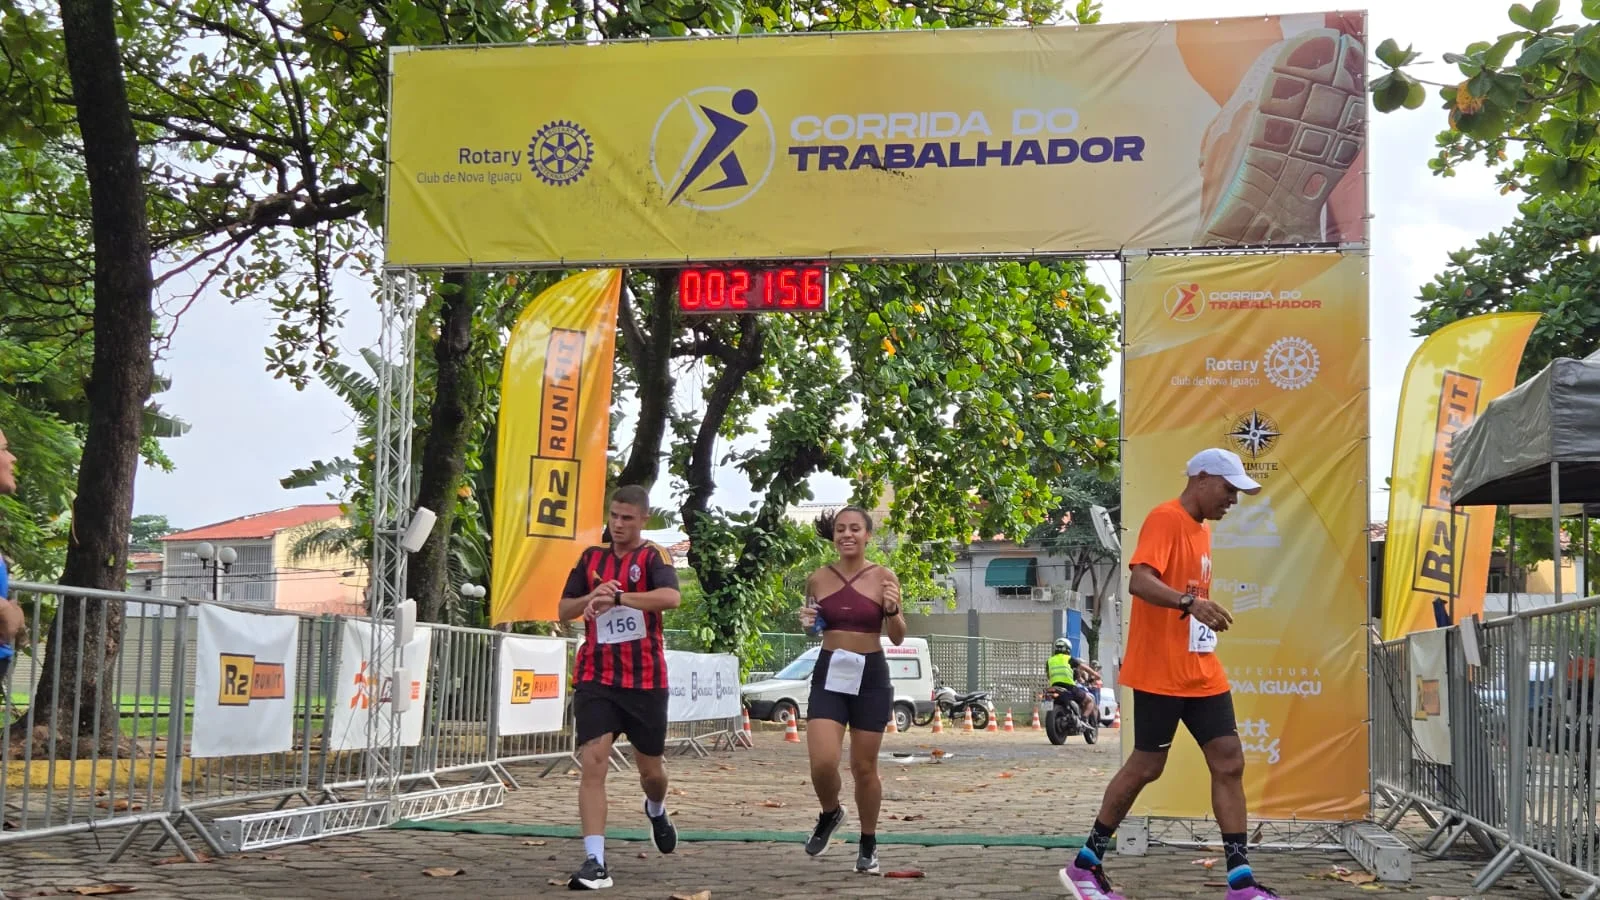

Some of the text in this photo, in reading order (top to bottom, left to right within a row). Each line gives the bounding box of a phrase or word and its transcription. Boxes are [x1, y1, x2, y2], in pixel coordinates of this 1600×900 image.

[790, 107, 1080, 142] CORRIDA DO
[459, 147, 522, 168] Rotary
[788, 135, 1146, 172] TRABALHADOR
[416, 170, 522, 186] Club de Nova Iguaçu
[1209, 290, 1302, 301] CORRIDA DO
[1208, 300, 1322, 310] TRABALHADOR
[1205, 357, 1259, 374] Rotary
[1171, 375, 1191, 386] Club
[1205, 376, 1228, 386] Nova
[536, 469, 570, 528] R2
[1213, 578, 1259, 594] Firjan
[606, 616, 637, 635] 156
[1198, 625, 1214, 641] 24
[224, 664, 249, 695] R2
[1260, 680, 1322, 699] IGUAÇU
